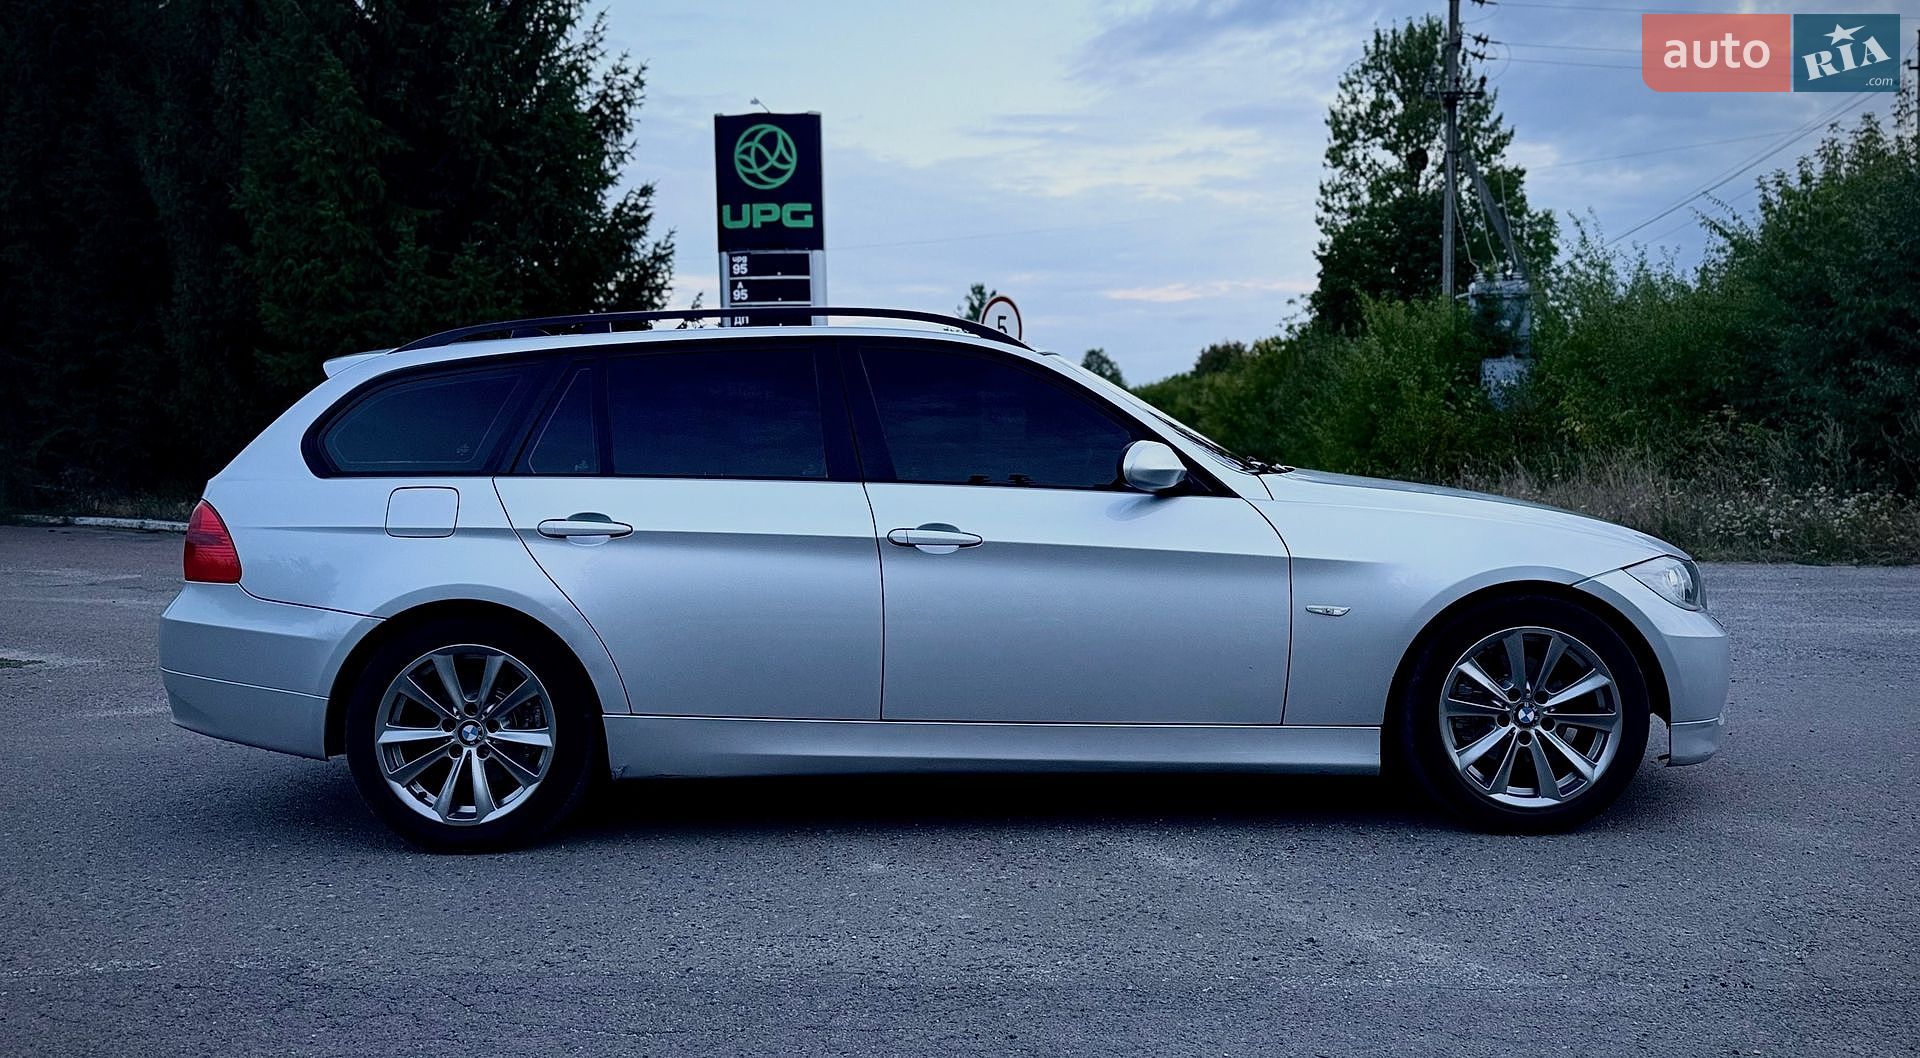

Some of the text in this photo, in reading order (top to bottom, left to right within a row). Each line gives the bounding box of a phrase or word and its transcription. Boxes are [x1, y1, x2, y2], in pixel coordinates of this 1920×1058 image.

[722, 203, 814, 229] UPG
[732, 263, 748, 275] 95
[732, 289, 749, 301] 95
[998, 316, 1008, 334] 5
